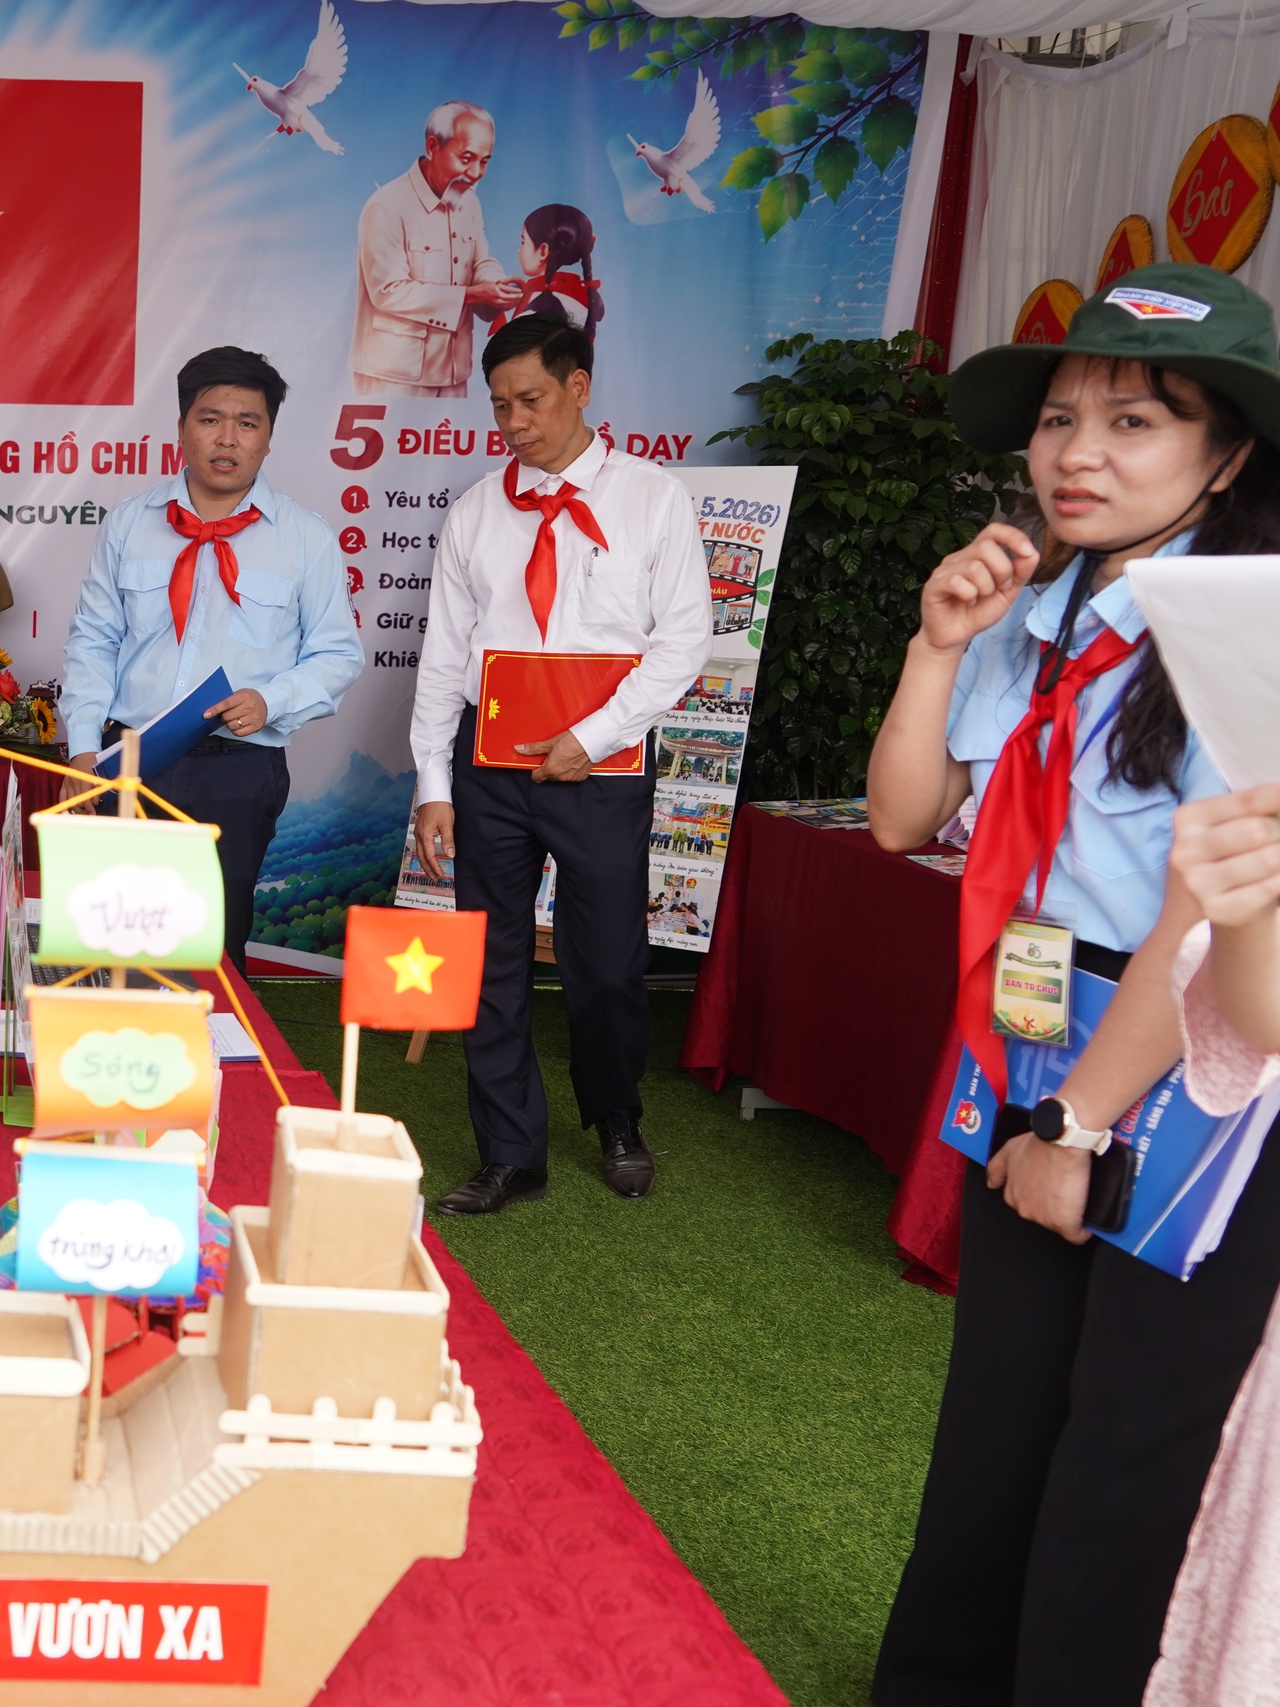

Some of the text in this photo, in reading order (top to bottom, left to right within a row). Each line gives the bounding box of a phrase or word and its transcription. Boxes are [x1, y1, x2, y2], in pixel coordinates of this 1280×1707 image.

[329, 404, 388, 471] 5
[397, 417, 476, 456] ĐIỀU
[626, 433, 694, 467] DẠY
[32, 431, 80, 475] HỒ
[91, 434, 151, 475] CHÍ
[384, 490, 421, 509] Yêu
[427, 487, 450, 509] tổ
[381, 531, 422, 553] Học
[710, 522, 766, 544] NƯỚC
[378, 572, 431, 590] Đoàn
[376, 612, 413, 629] Giữ
[373, 651, 419, 668] Khiê
[7, 1595, 145, 1660] VƯƠN
[153, 1603, 224, 1661] XA
